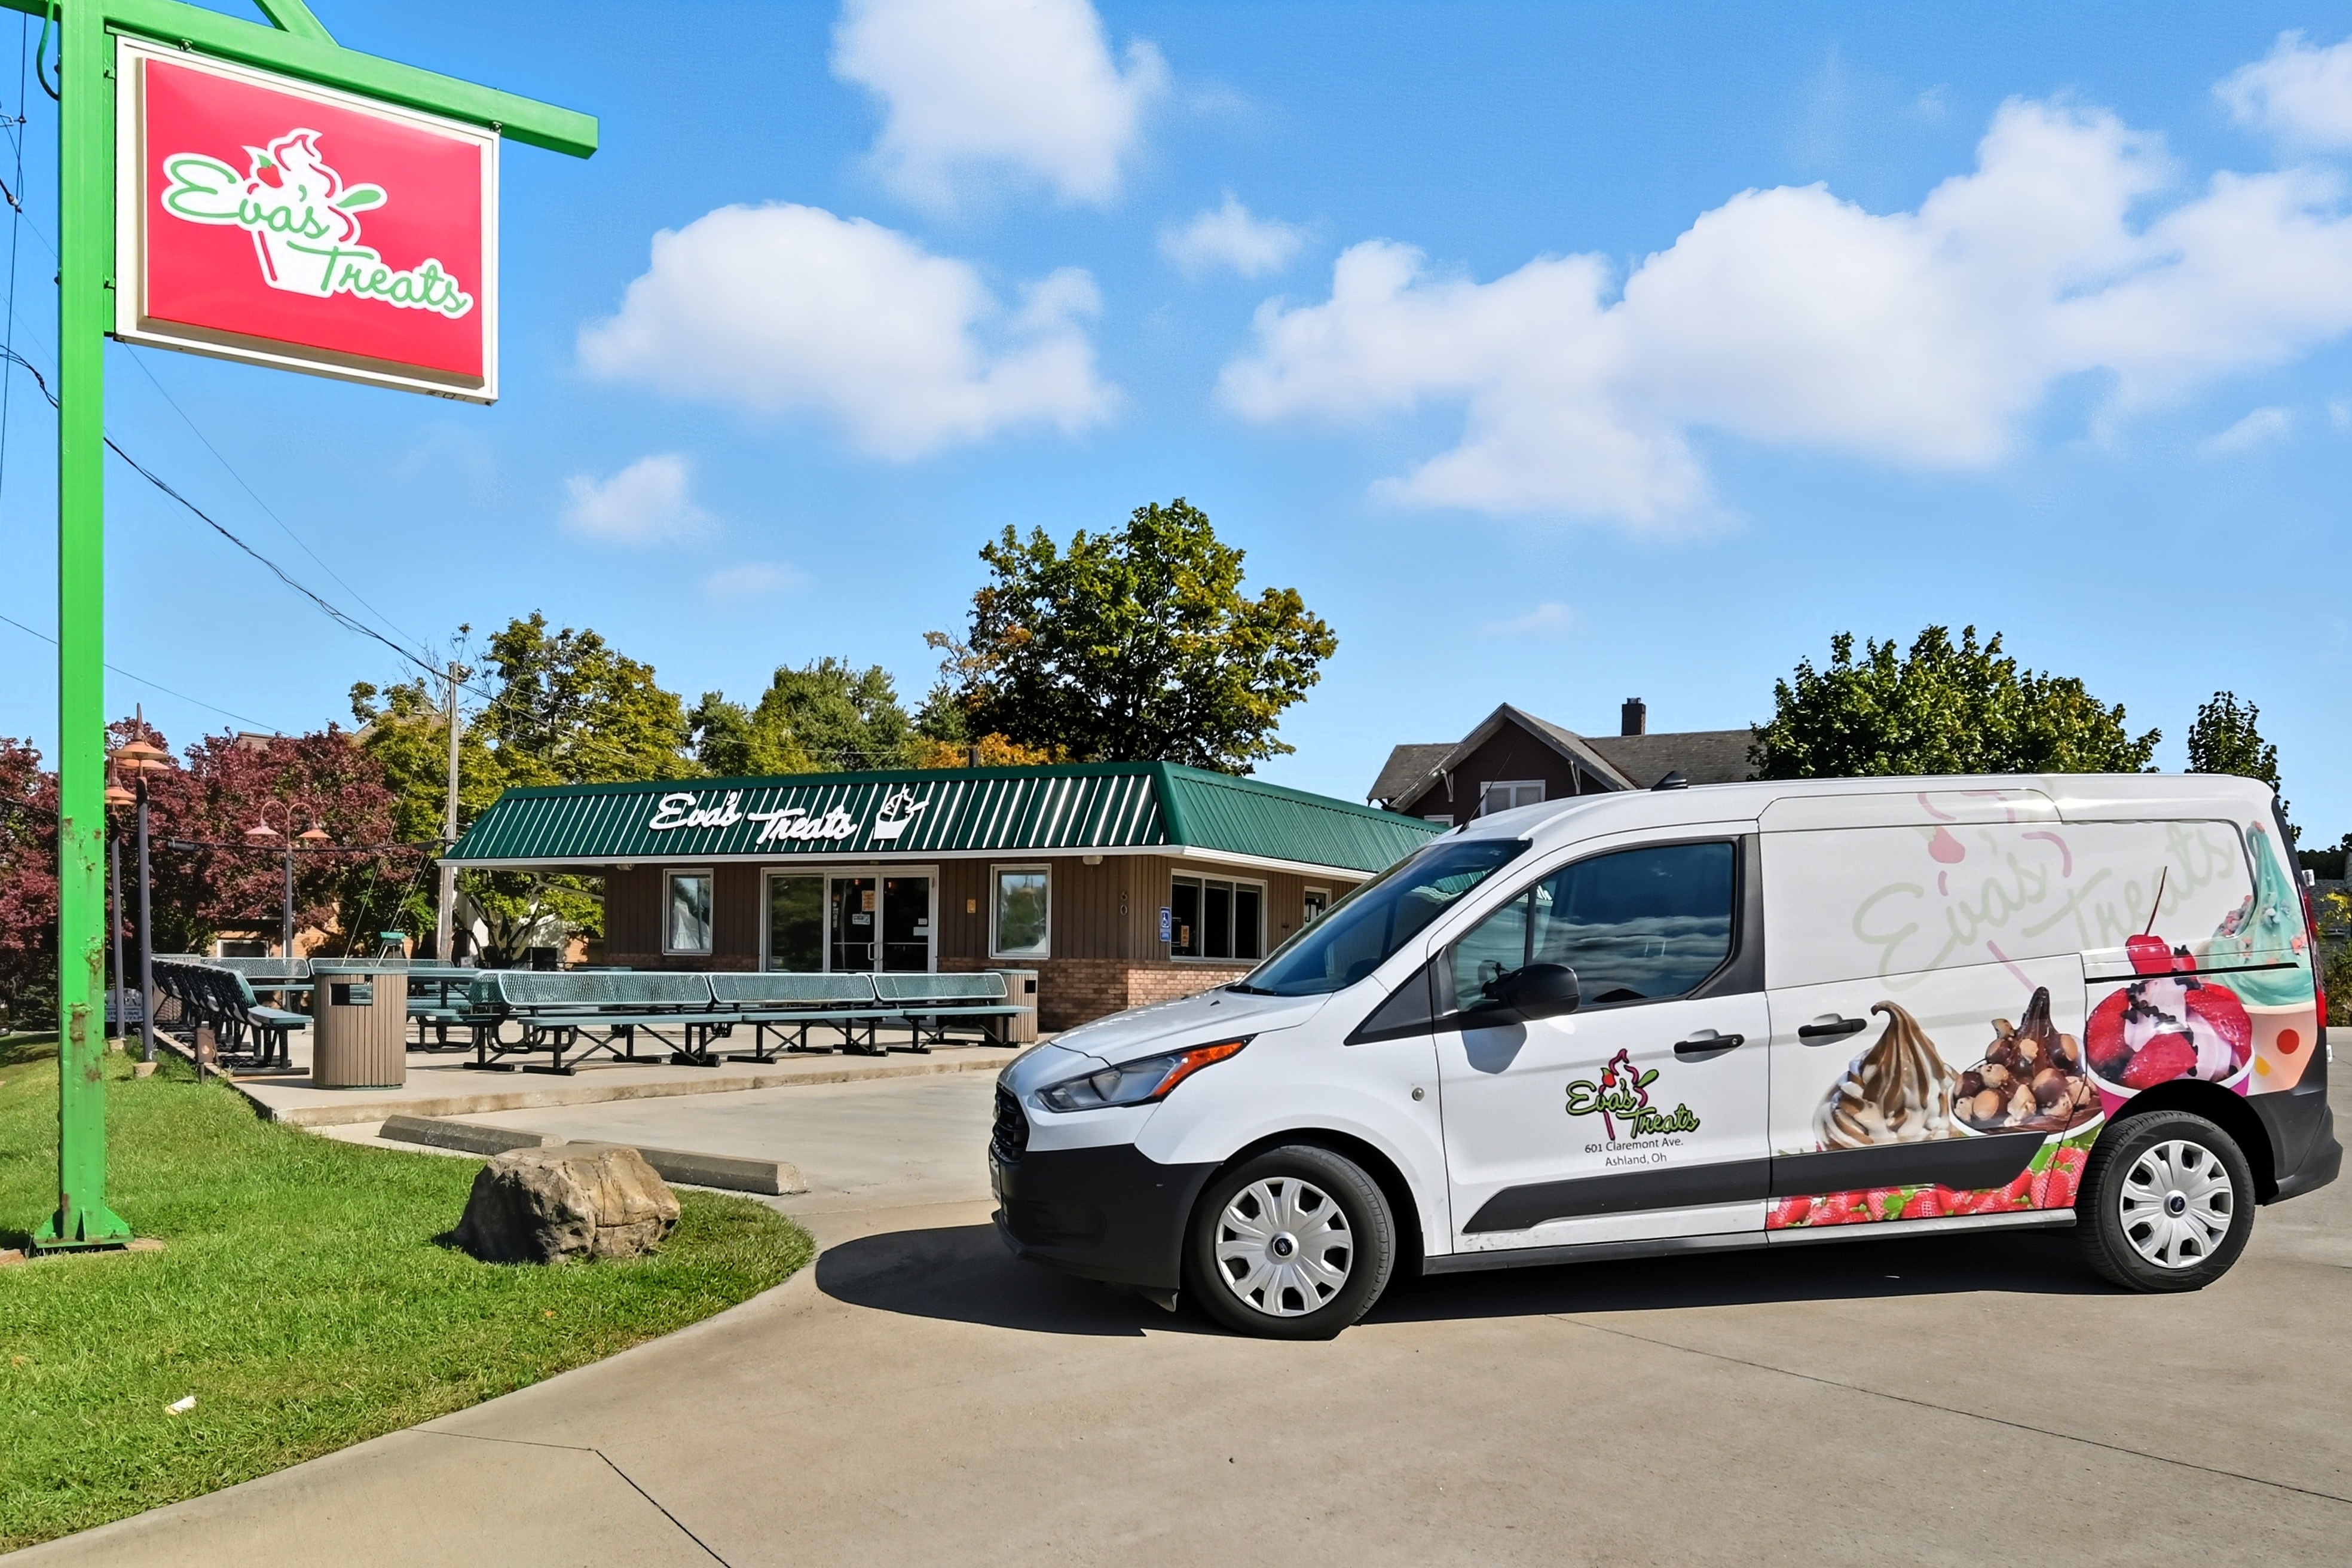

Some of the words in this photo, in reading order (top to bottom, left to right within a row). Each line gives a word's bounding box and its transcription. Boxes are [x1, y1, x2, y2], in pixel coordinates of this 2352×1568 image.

[168, 159, 330, 239] Eva's
[286, 240, 467, 311] Treats
[649, 792, 742, 829] Eva's
[747, 804, 858, 845] Treats
[1853, 827, 2048, 993] Eva's
[2021, 823, 2235, 971] Treats
[1565, 1078, 1637, 1116] Eva's
[1616, 1103, 1700, 1139] Treats
[1585, 1144, 1602, 1153] 601
[1606, 1139, 1659, 1152] Claremont
[1662, 1137, 1684, 1147] Ave.
[1605, 1154, 1650, 1166] Ashland,
[1651, 1152, 1667, 1163] Oh
